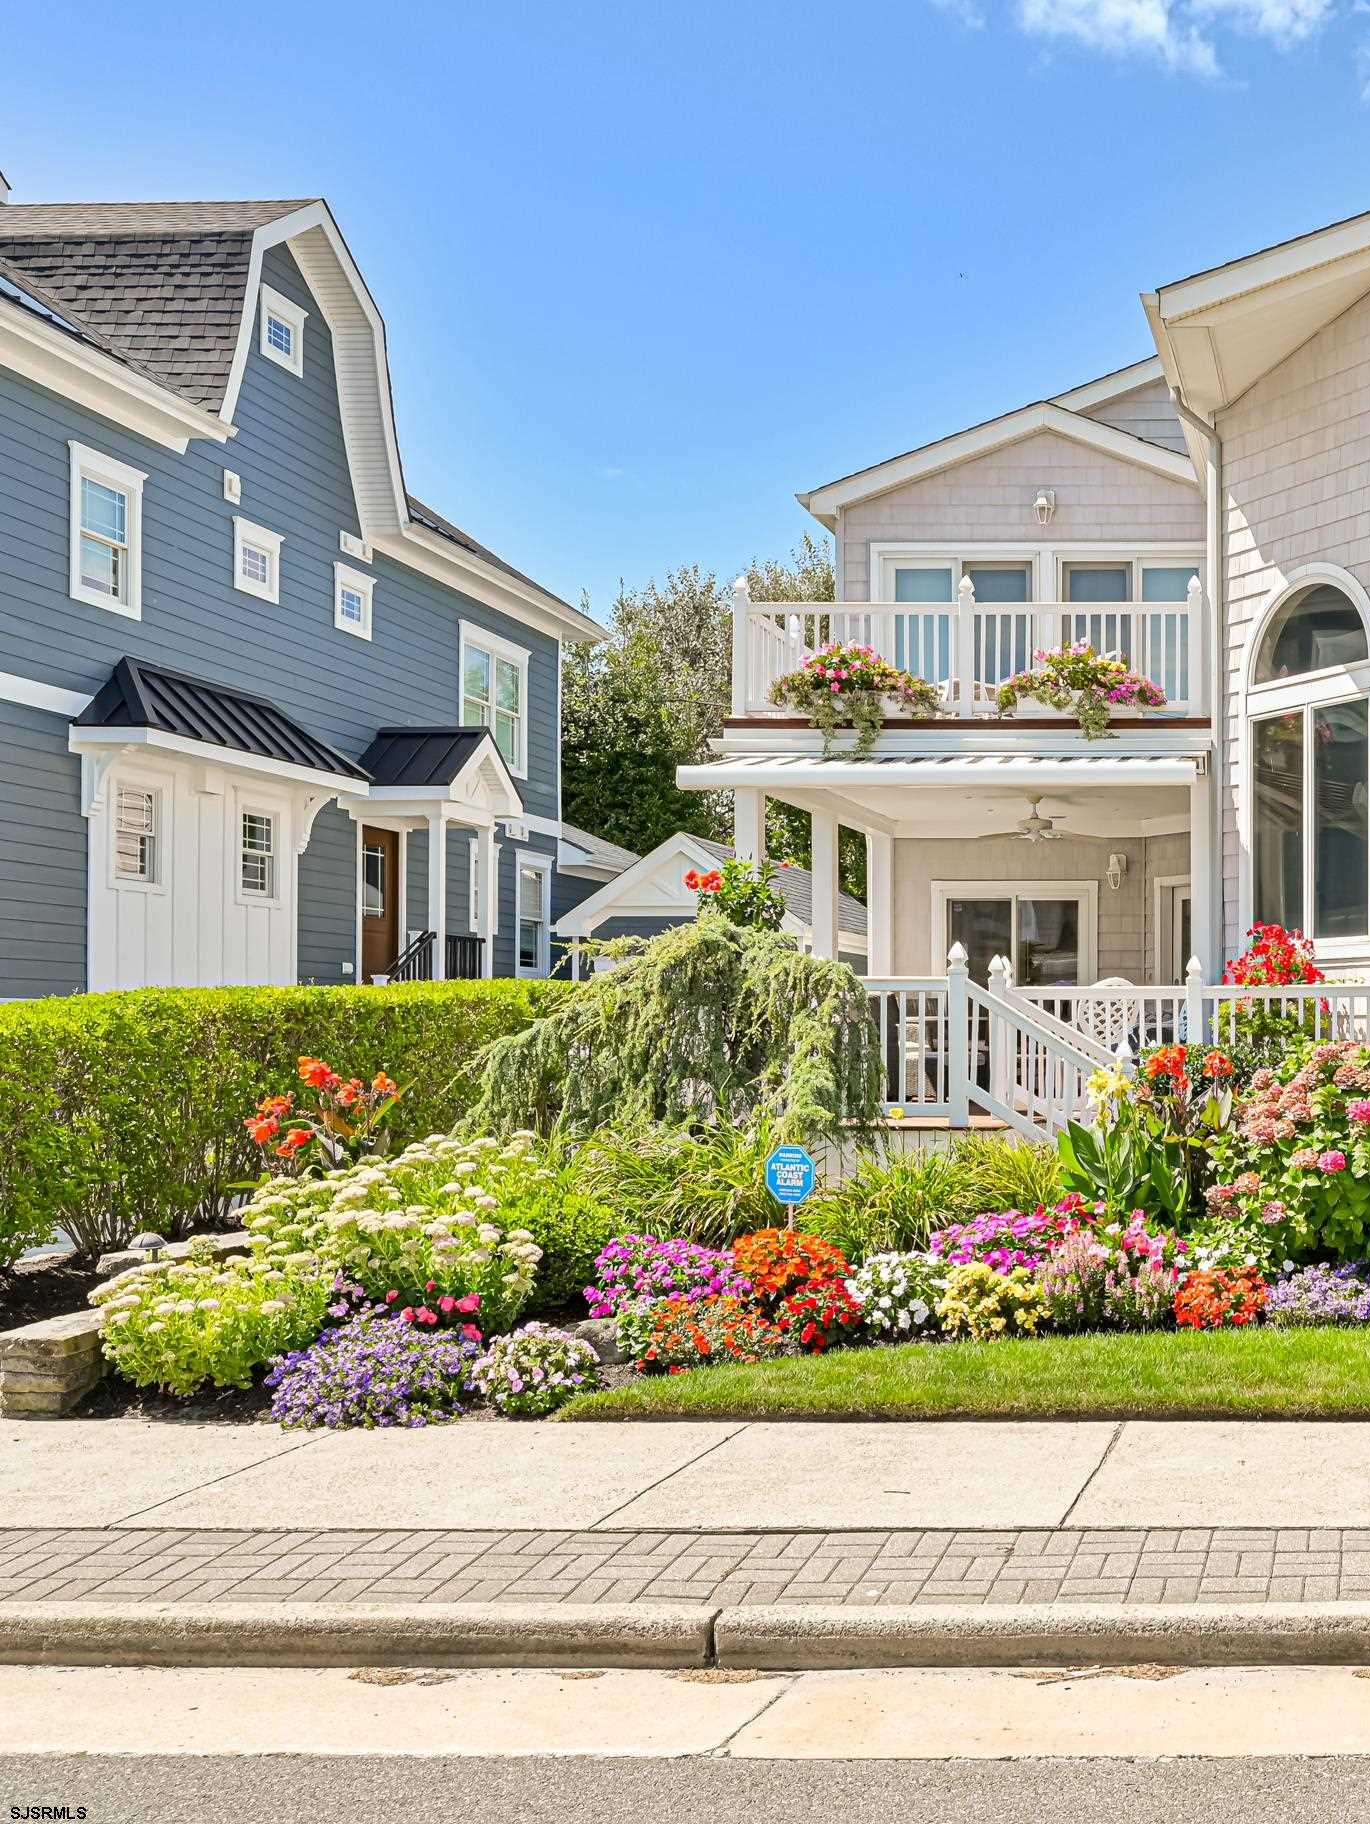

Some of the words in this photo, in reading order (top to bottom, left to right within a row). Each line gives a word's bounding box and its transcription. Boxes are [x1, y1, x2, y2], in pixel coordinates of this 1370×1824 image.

[770, 1163, 810, 1172] ATLANTIC
[777, 1171, 804, 1179] COAST
[776, 1178, 803, 1186] ALARM
